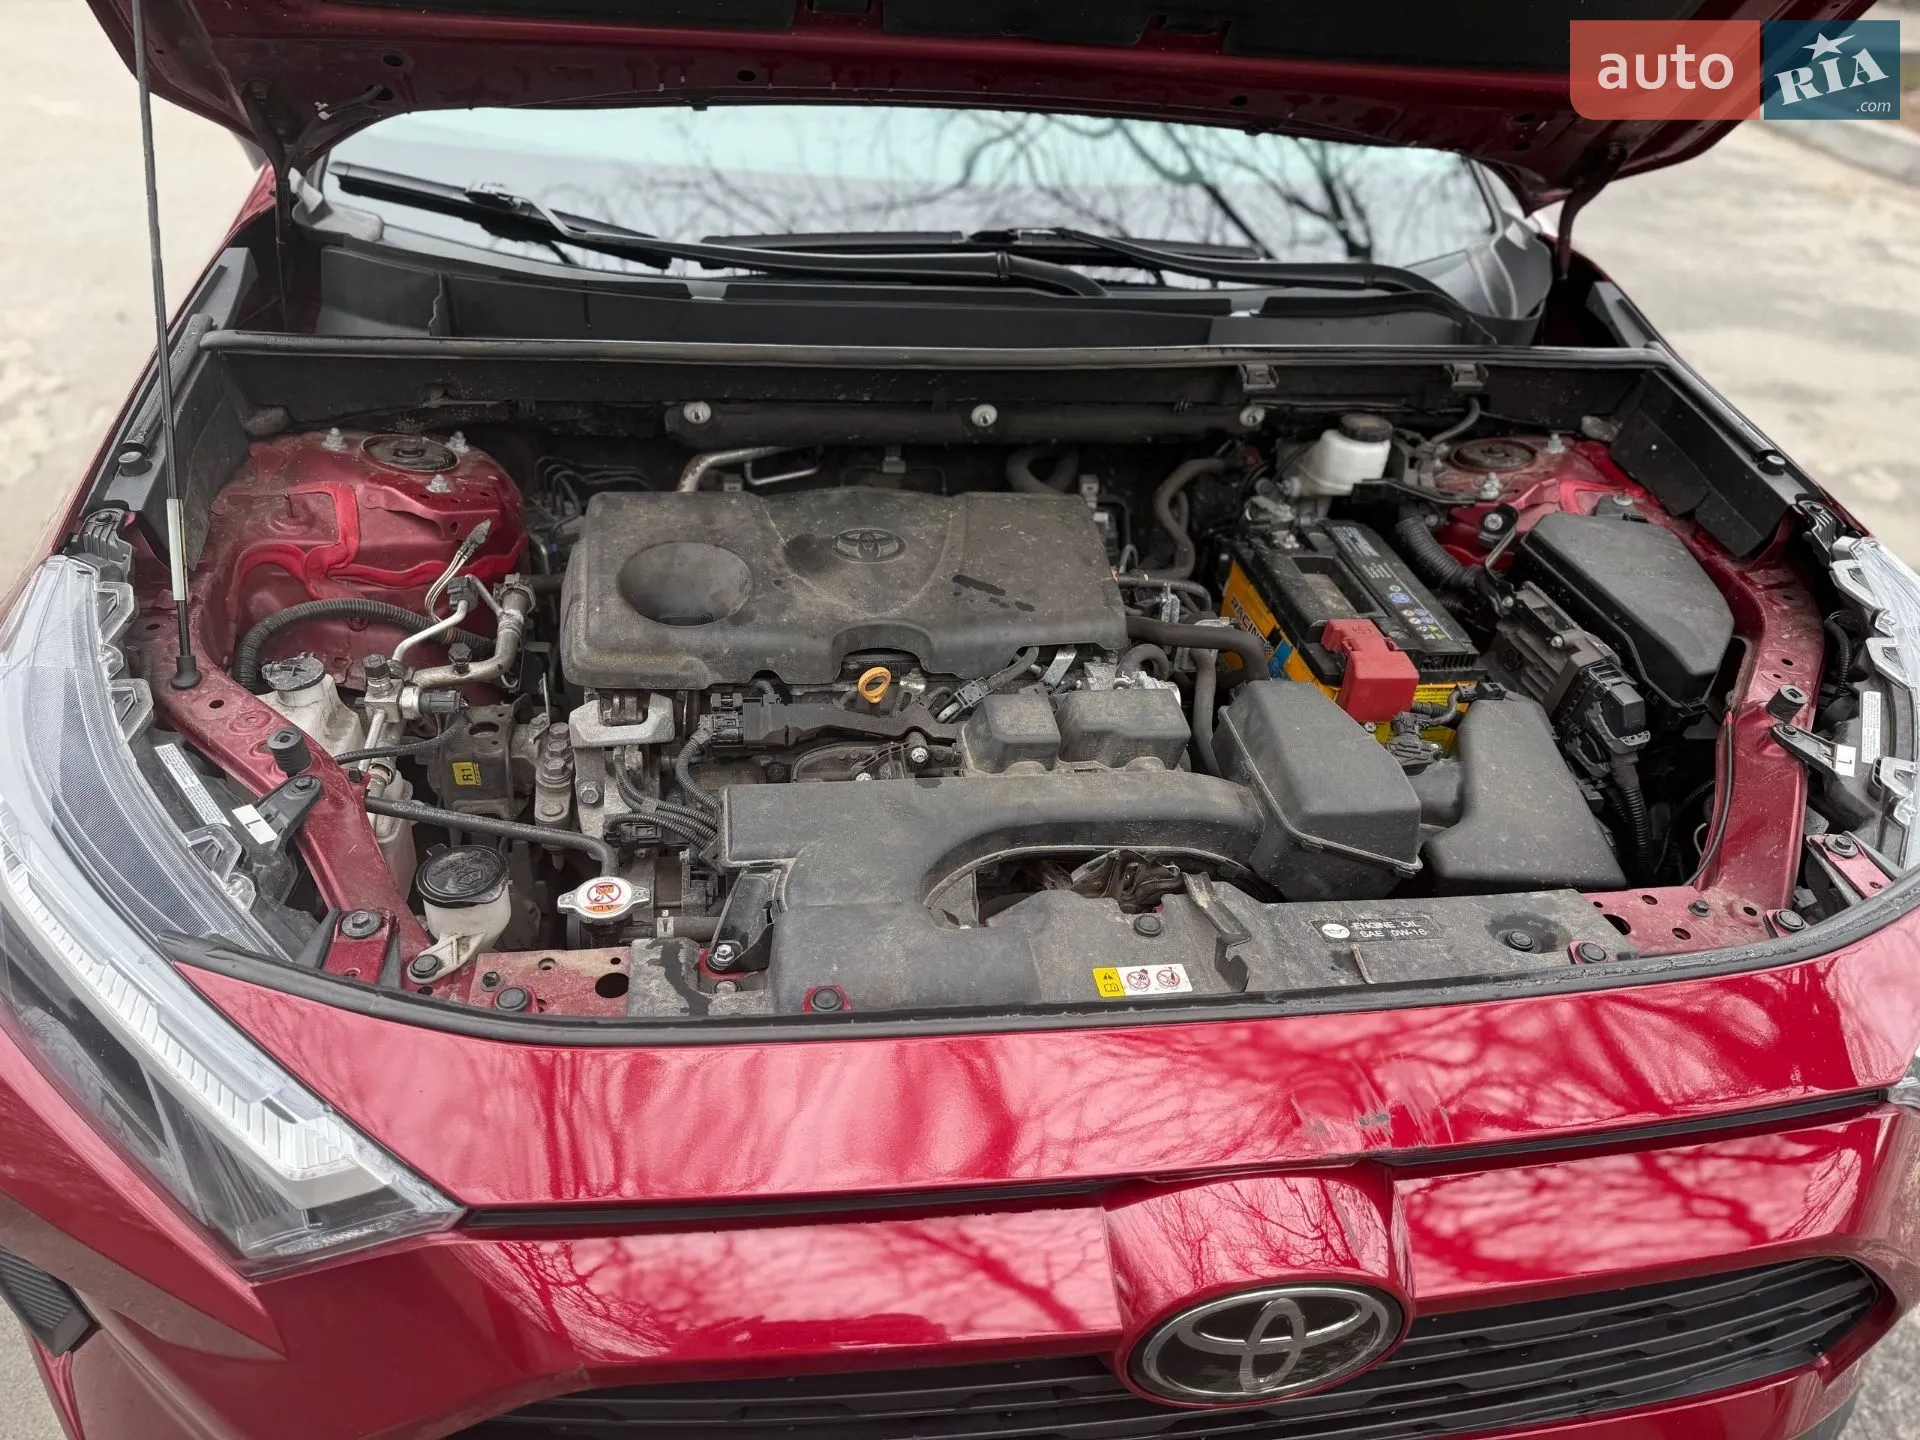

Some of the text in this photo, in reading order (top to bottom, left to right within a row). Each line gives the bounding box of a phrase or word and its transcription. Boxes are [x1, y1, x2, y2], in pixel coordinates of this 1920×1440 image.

[460, 768, 474, 782] R1
[1352, 920, 1421, 930] ENGINE OIL
[1360, 930, 1385, 938] SAE
